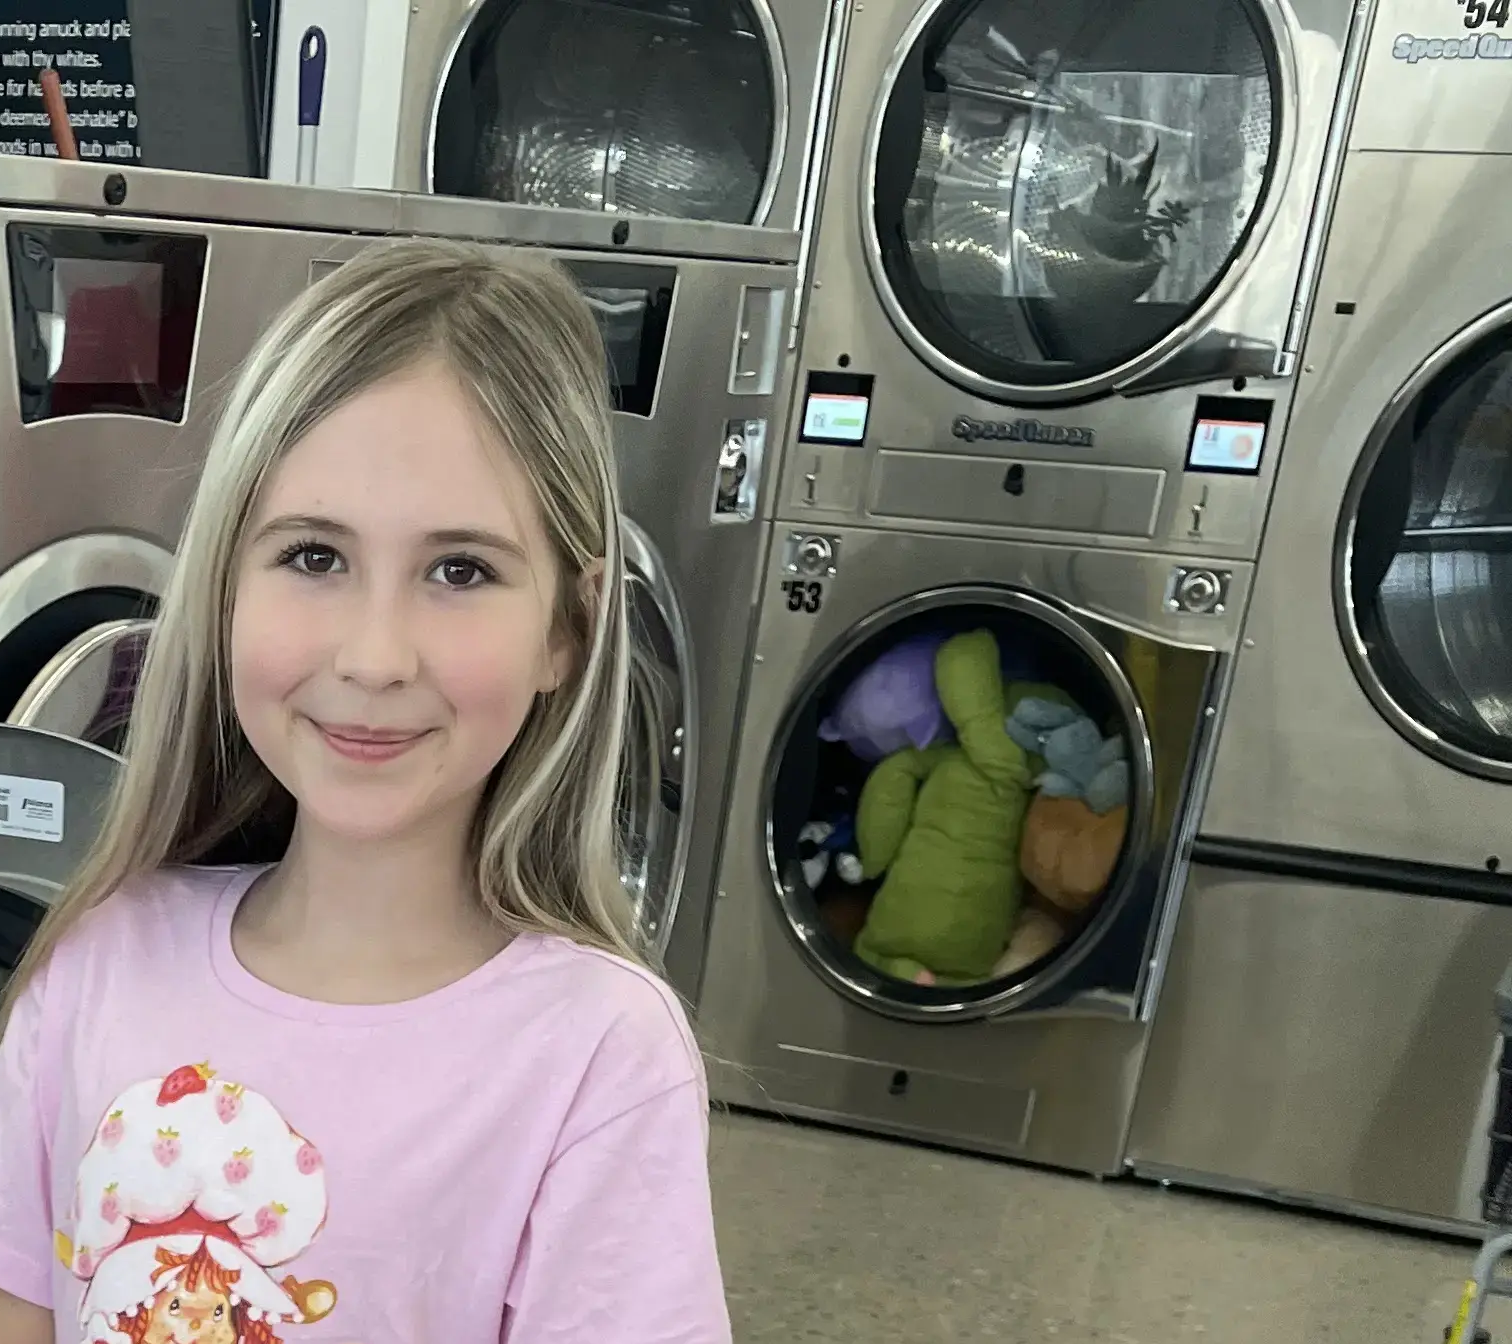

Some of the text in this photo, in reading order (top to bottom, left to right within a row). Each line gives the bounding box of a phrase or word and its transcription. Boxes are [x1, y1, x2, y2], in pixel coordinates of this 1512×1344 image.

[39, 20, 83, 38] amuck
[84, 20, 111, 38] and
[112, 20, 132, 41] pla
[1392, 32, 1512, 64] SpeedQu
[2, 50, 30, 68] with
[32, 50, 55, 70] thy
[55, 50, 103, 68] whites.
[6, 79, 27, 97] for
[79, 80, 123, 98] before
[124, 83, 136, 98] a
[127, 110, 139, 129] b
[29, 139, 43, 156] in
[104, 140, 135, 158] with
